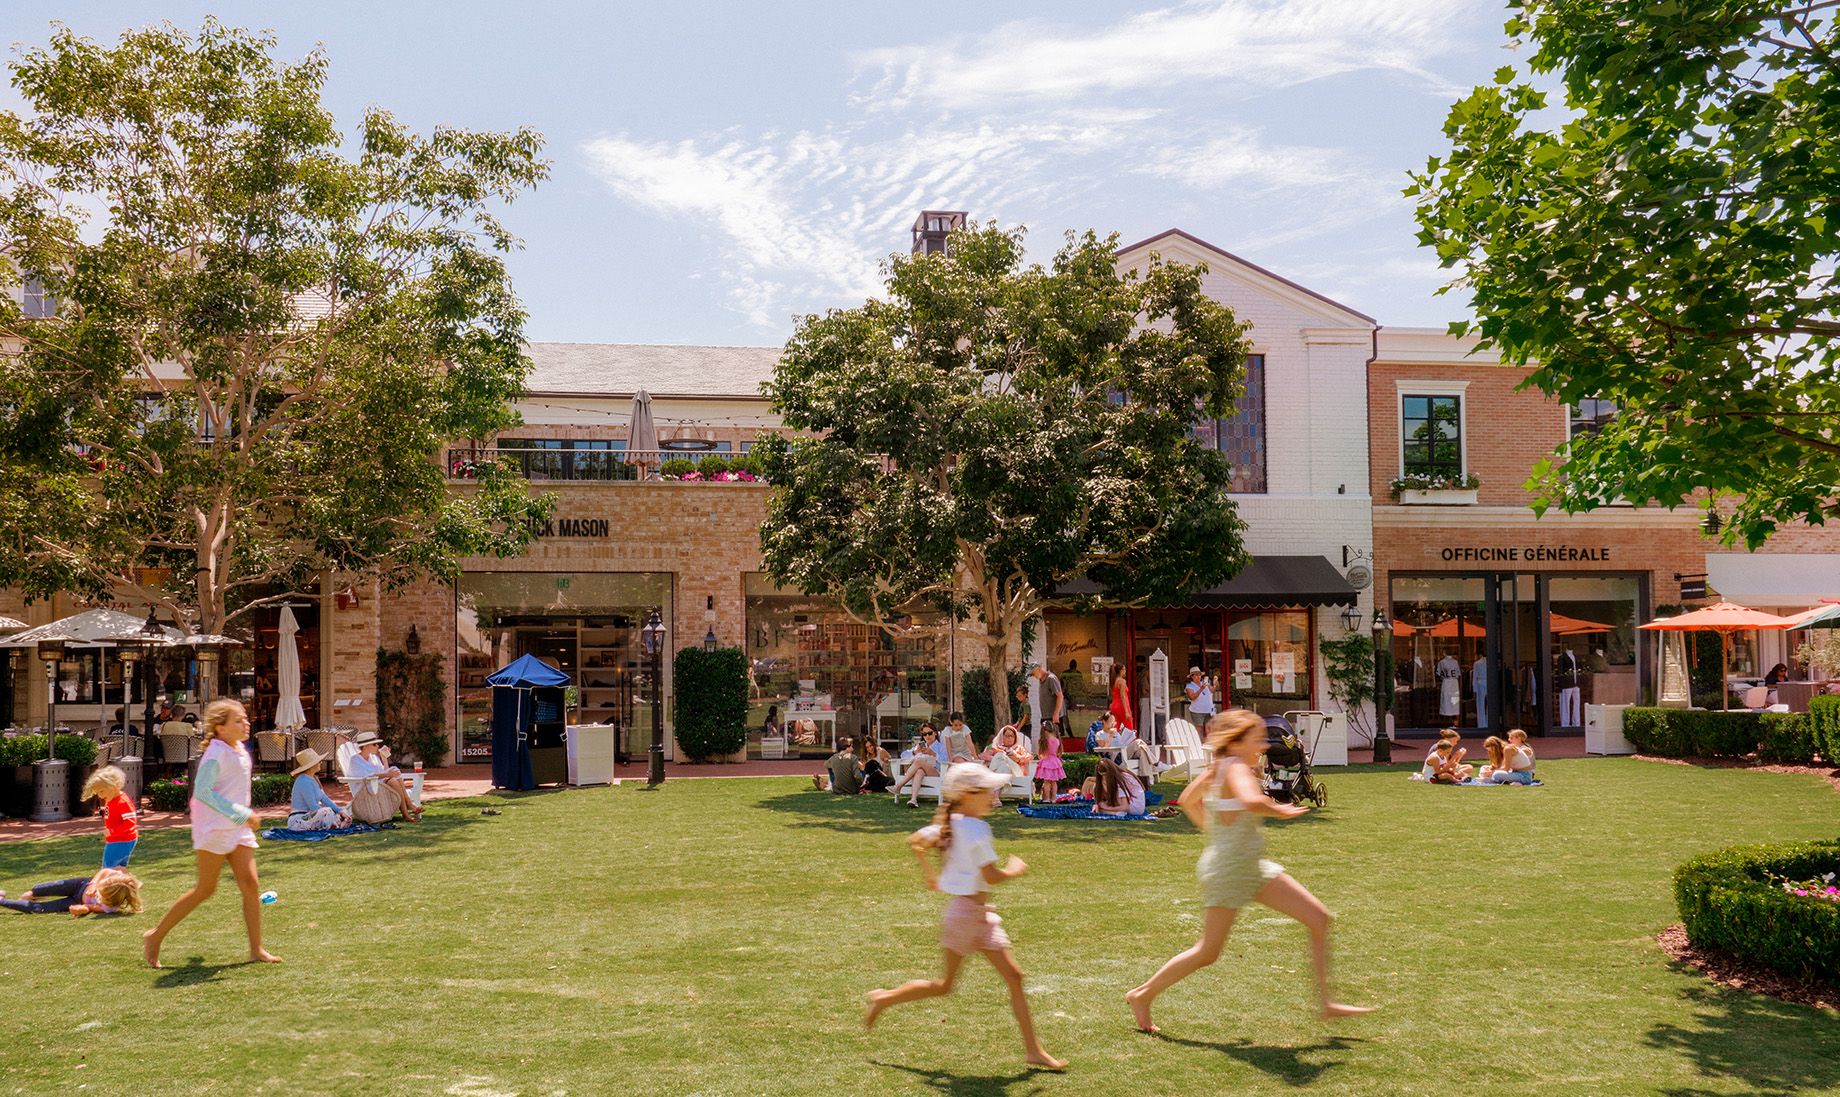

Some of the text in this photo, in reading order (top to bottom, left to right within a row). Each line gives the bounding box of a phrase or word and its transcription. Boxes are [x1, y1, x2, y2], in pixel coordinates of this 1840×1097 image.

[559, 519, 609, 537] MASON
[1441, 545, 1610, 561] OFFICINE GÉNÉRALE
[1436, 669, 1456, 678] ALE
[462, 748, 488, 756] 15205
